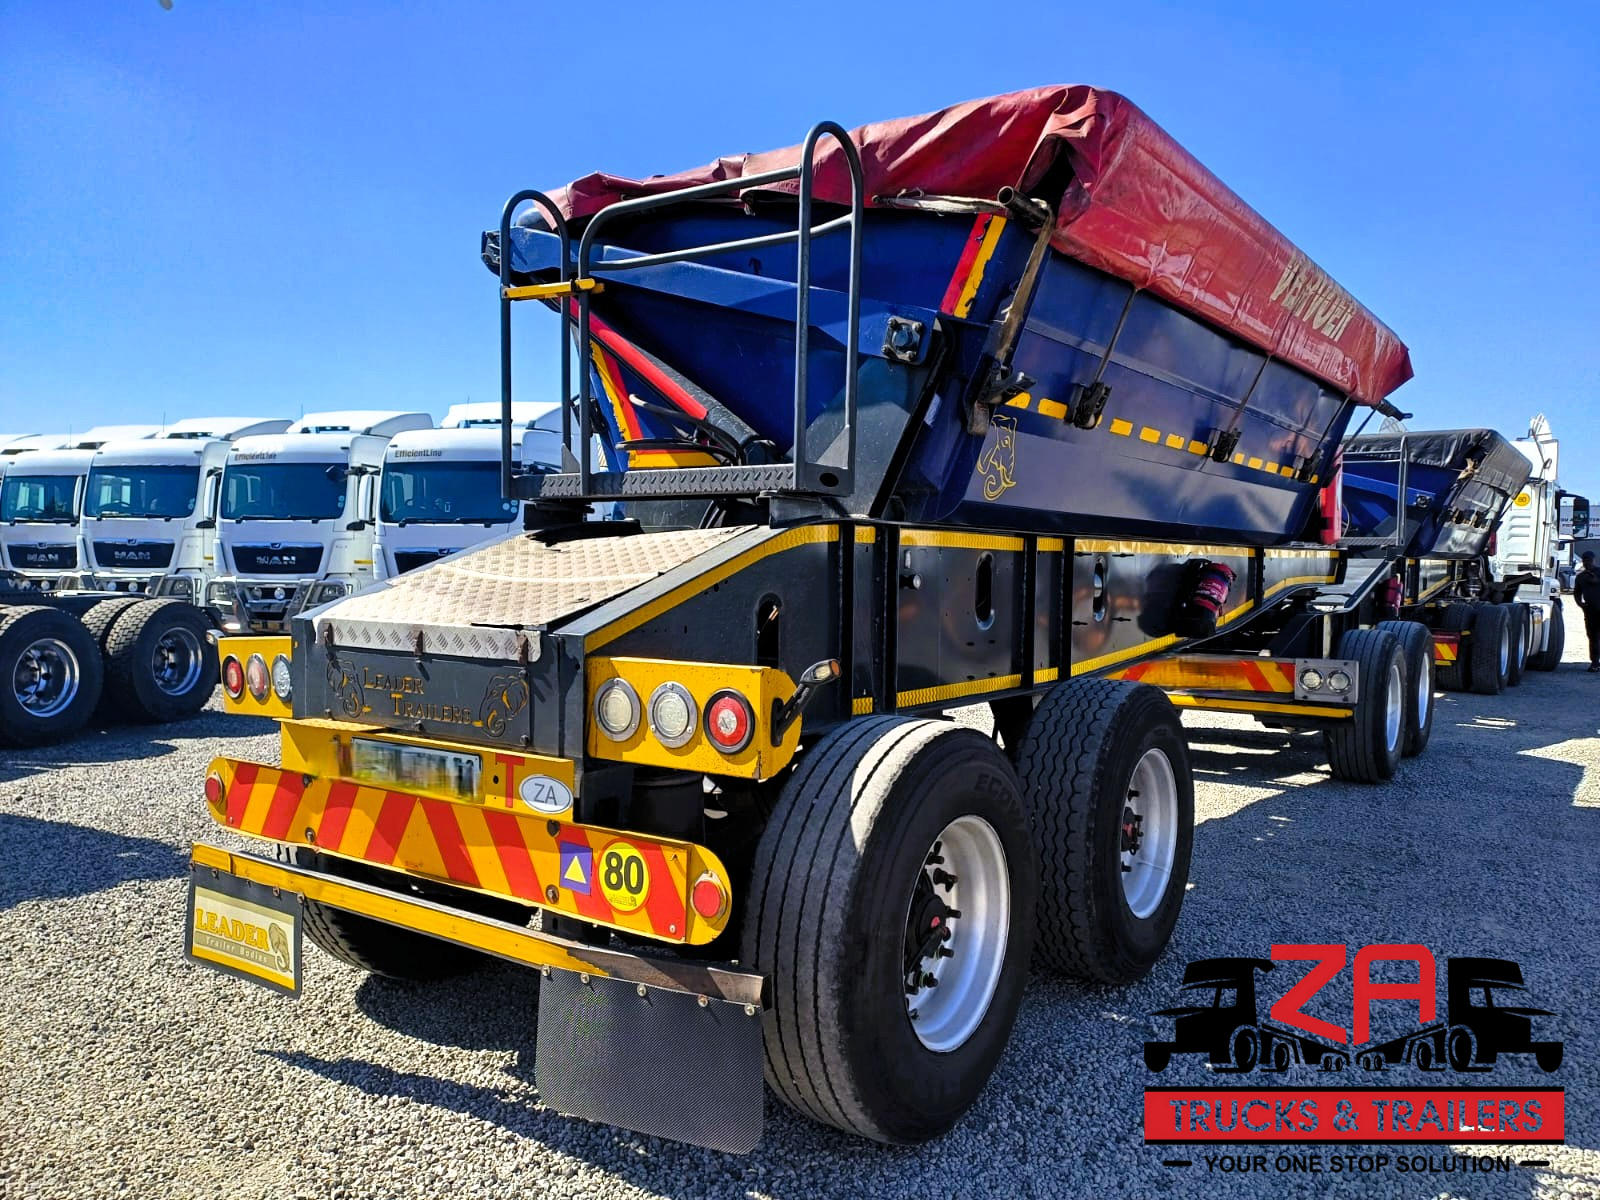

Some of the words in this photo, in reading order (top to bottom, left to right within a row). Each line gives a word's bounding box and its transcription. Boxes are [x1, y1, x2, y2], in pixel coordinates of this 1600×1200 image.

[394, 449, 442, 458] EfficientLine
[27, 553, 59, 562] MAN
[114, 551, 151, 560] MAN
[256, 555, 297, 565] MAN
[495, 752, 525, 808] T
[533, 783, 558, 806] ZA
[604, 851, 645, 895] 80
[195, 908, 270, 952] LEADER
